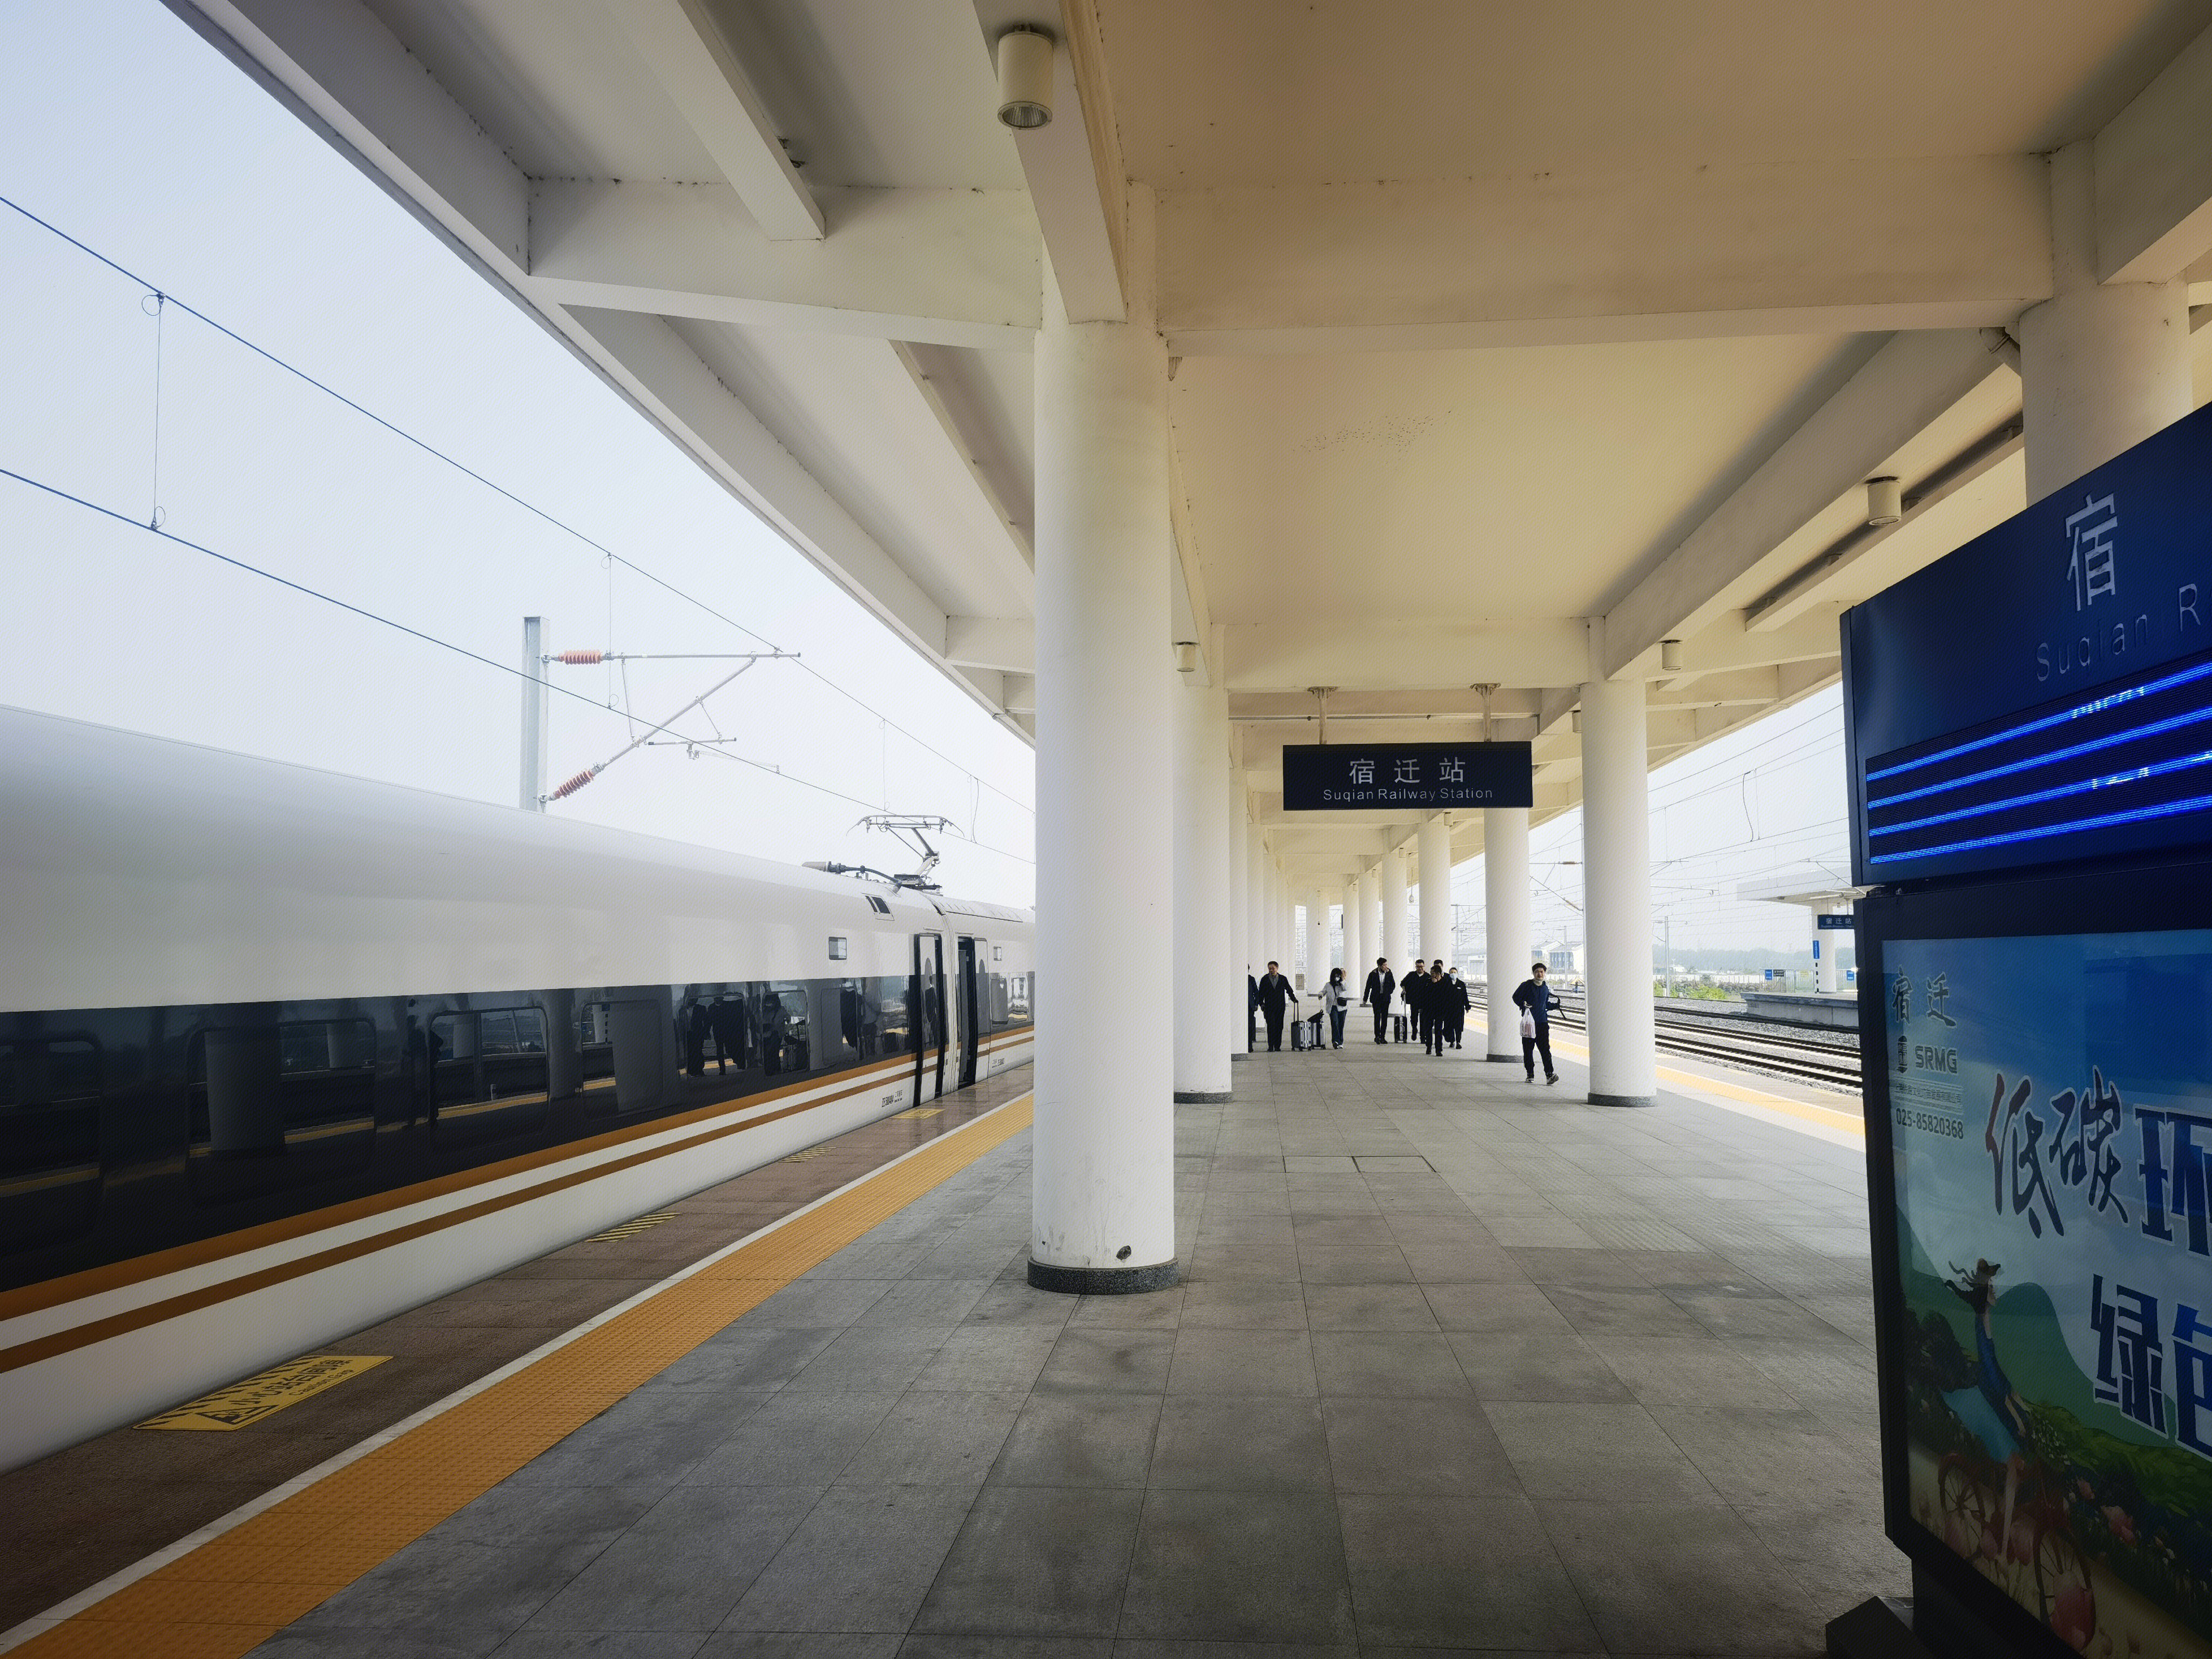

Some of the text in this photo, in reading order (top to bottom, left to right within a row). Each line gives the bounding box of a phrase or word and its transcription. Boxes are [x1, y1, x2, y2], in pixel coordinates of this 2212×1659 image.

[2064, 491, 2119, 612] 宿
[2036, 614, 2148, 682] Suqian
[1349, 757, 1466, 784] 宿迁站
[1323, 787, 1493, 802] Suqian Railway Station
[1892, 965, 1957, 1028] 宿迁
[1915, 1046, 1958, 1074] SRMG
[1896, 1108, 1964, 1139] 025-85820368
[228, 1360, 353, 1405] 小心站台间隙
[288, 1369, 354, 1395] Caution Gap
